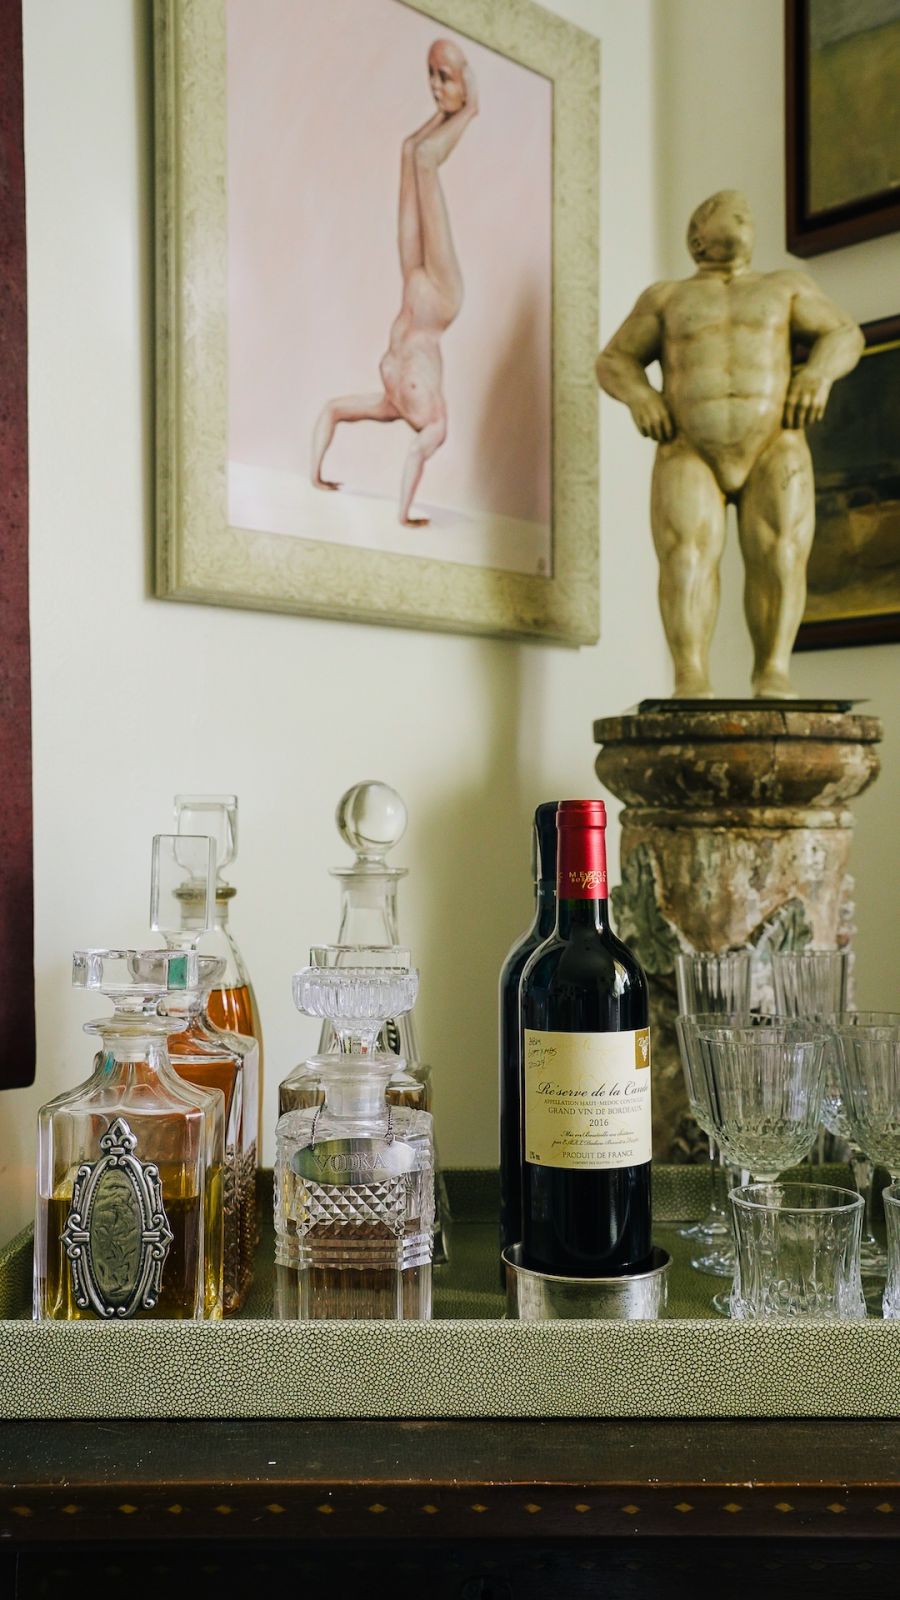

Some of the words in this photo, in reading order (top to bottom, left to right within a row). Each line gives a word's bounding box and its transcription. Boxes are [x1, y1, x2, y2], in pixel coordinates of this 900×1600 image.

[535, 1081, 588, 1097] Réserve
[591, 1083, 606, 1097] de
[608, 1082, 621, 1096] la
[548, 1107, 576, 1115] GRAND
[589, 1119, 609, 1127] 2016
[562, 1151, 594, 1159] PRODUIT
[596, 1151, 606, 1159] DE
[608, 1149, 633, 1159] FRANCE
[313, 1151, 392, 1173] VODKA
